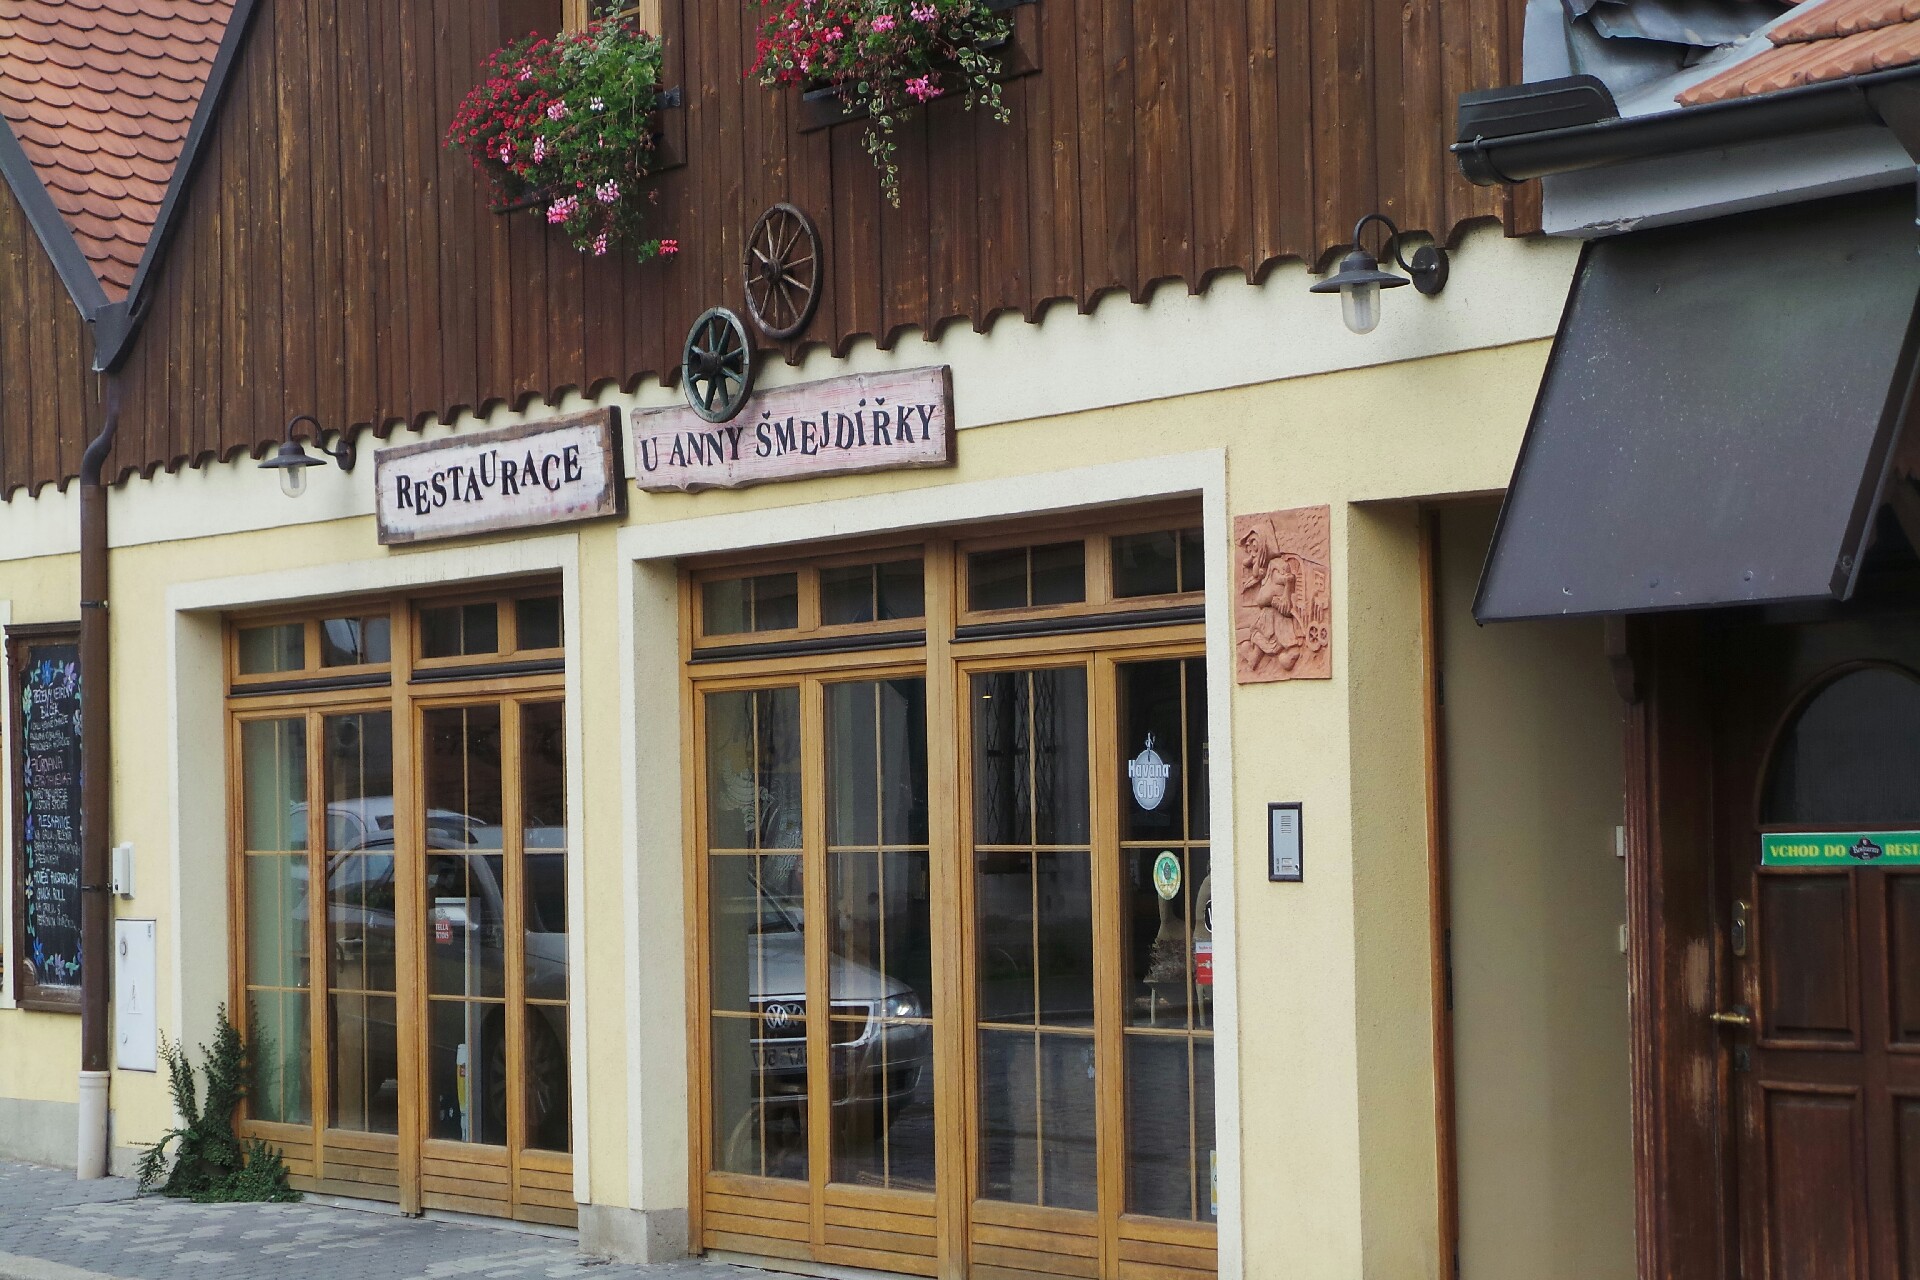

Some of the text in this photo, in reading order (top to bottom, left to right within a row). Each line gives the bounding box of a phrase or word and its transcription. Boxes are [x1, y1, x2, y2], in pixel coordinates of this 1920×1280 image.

[640, 397, 936, 471] U ANNY ŠMEJDÍŘKY
[395, 444, 582, 516] RESTAURACE
[1128, 760, 1169, 778] Havana
[1137, 780, 1160, 798] Club
[1770, 844, 1819, 857] VCHOD
[1824, 844, 1846, 857] DO
[1885, 843, 1920, 857] REST
